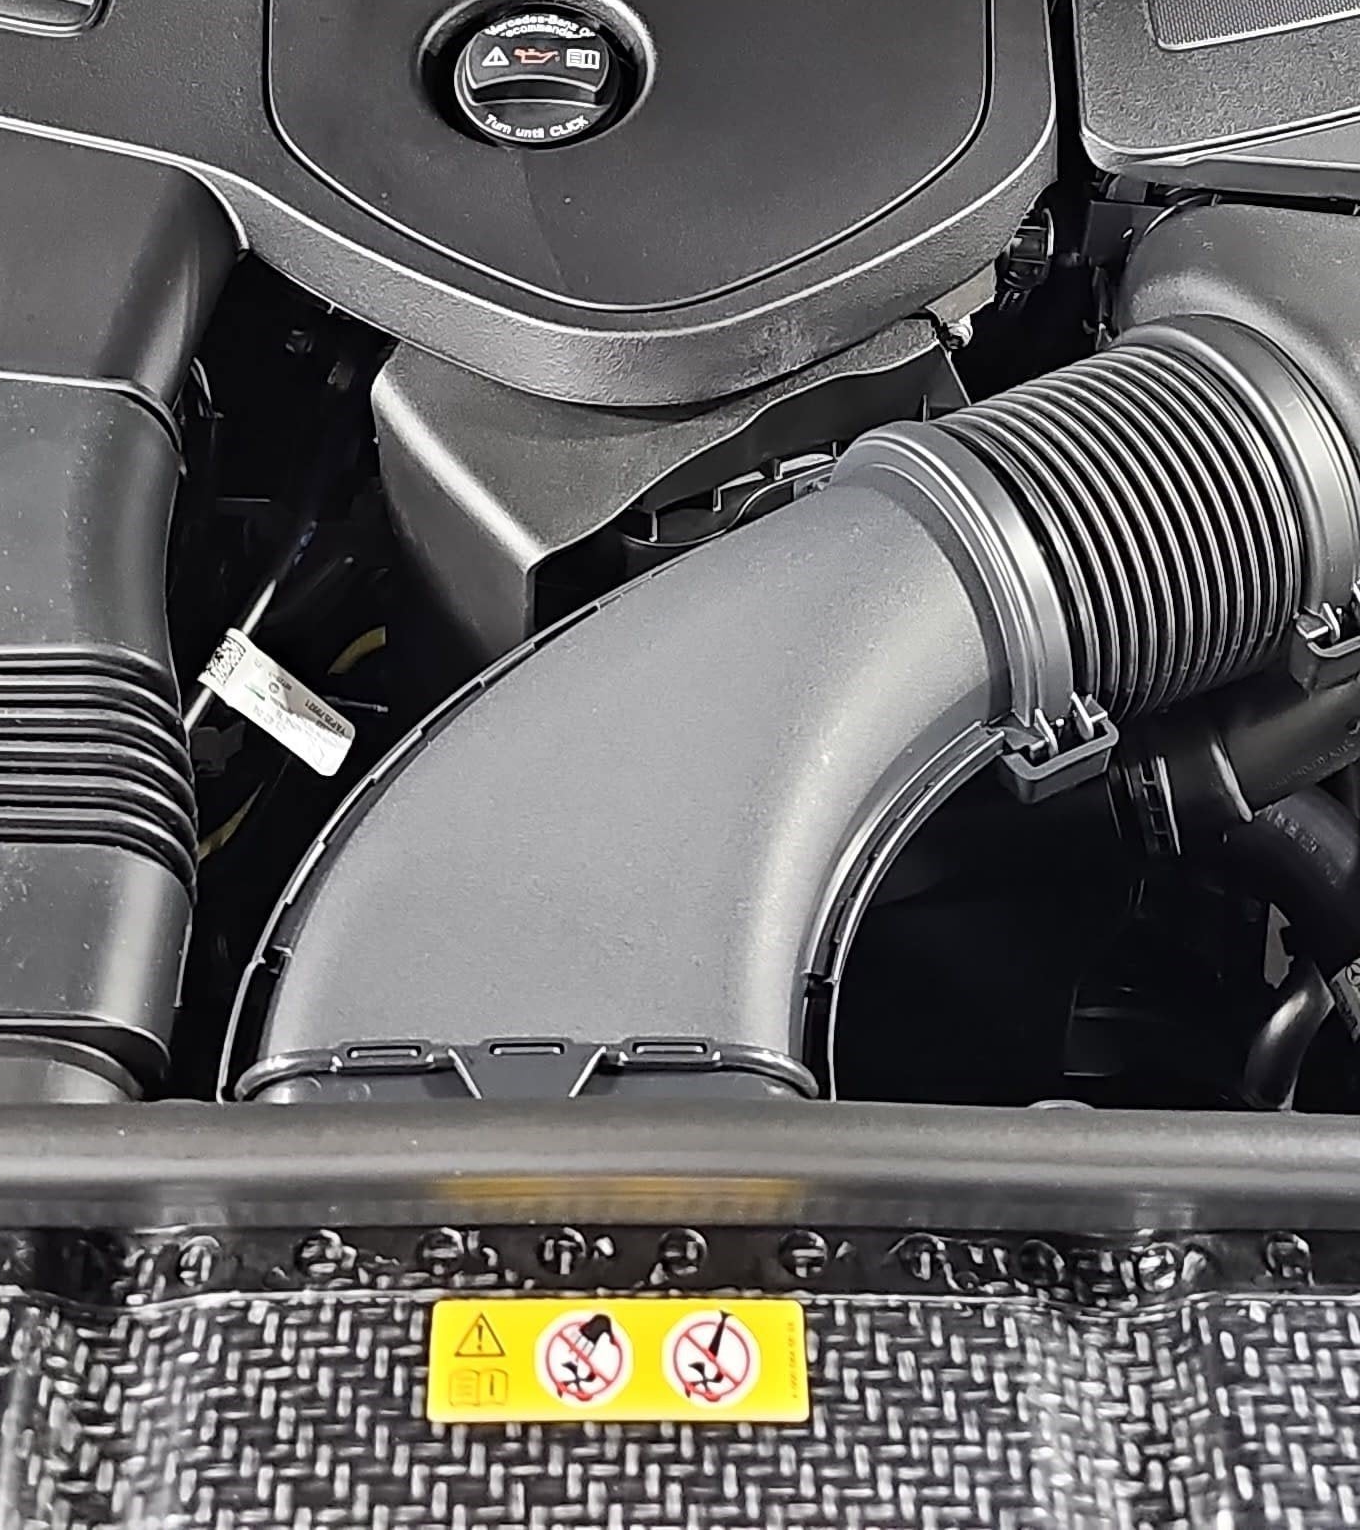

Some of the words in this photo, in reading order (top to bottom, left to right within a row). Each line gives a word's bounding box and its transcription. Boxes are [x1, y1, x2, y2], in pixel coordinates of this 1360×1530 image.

[483, 14, 579, 36] Mercedes-Benz
[485, 113, 512, 135] Turn
[515, 127, 545, 139] until
[550, 115, 589, 138] CLICK
